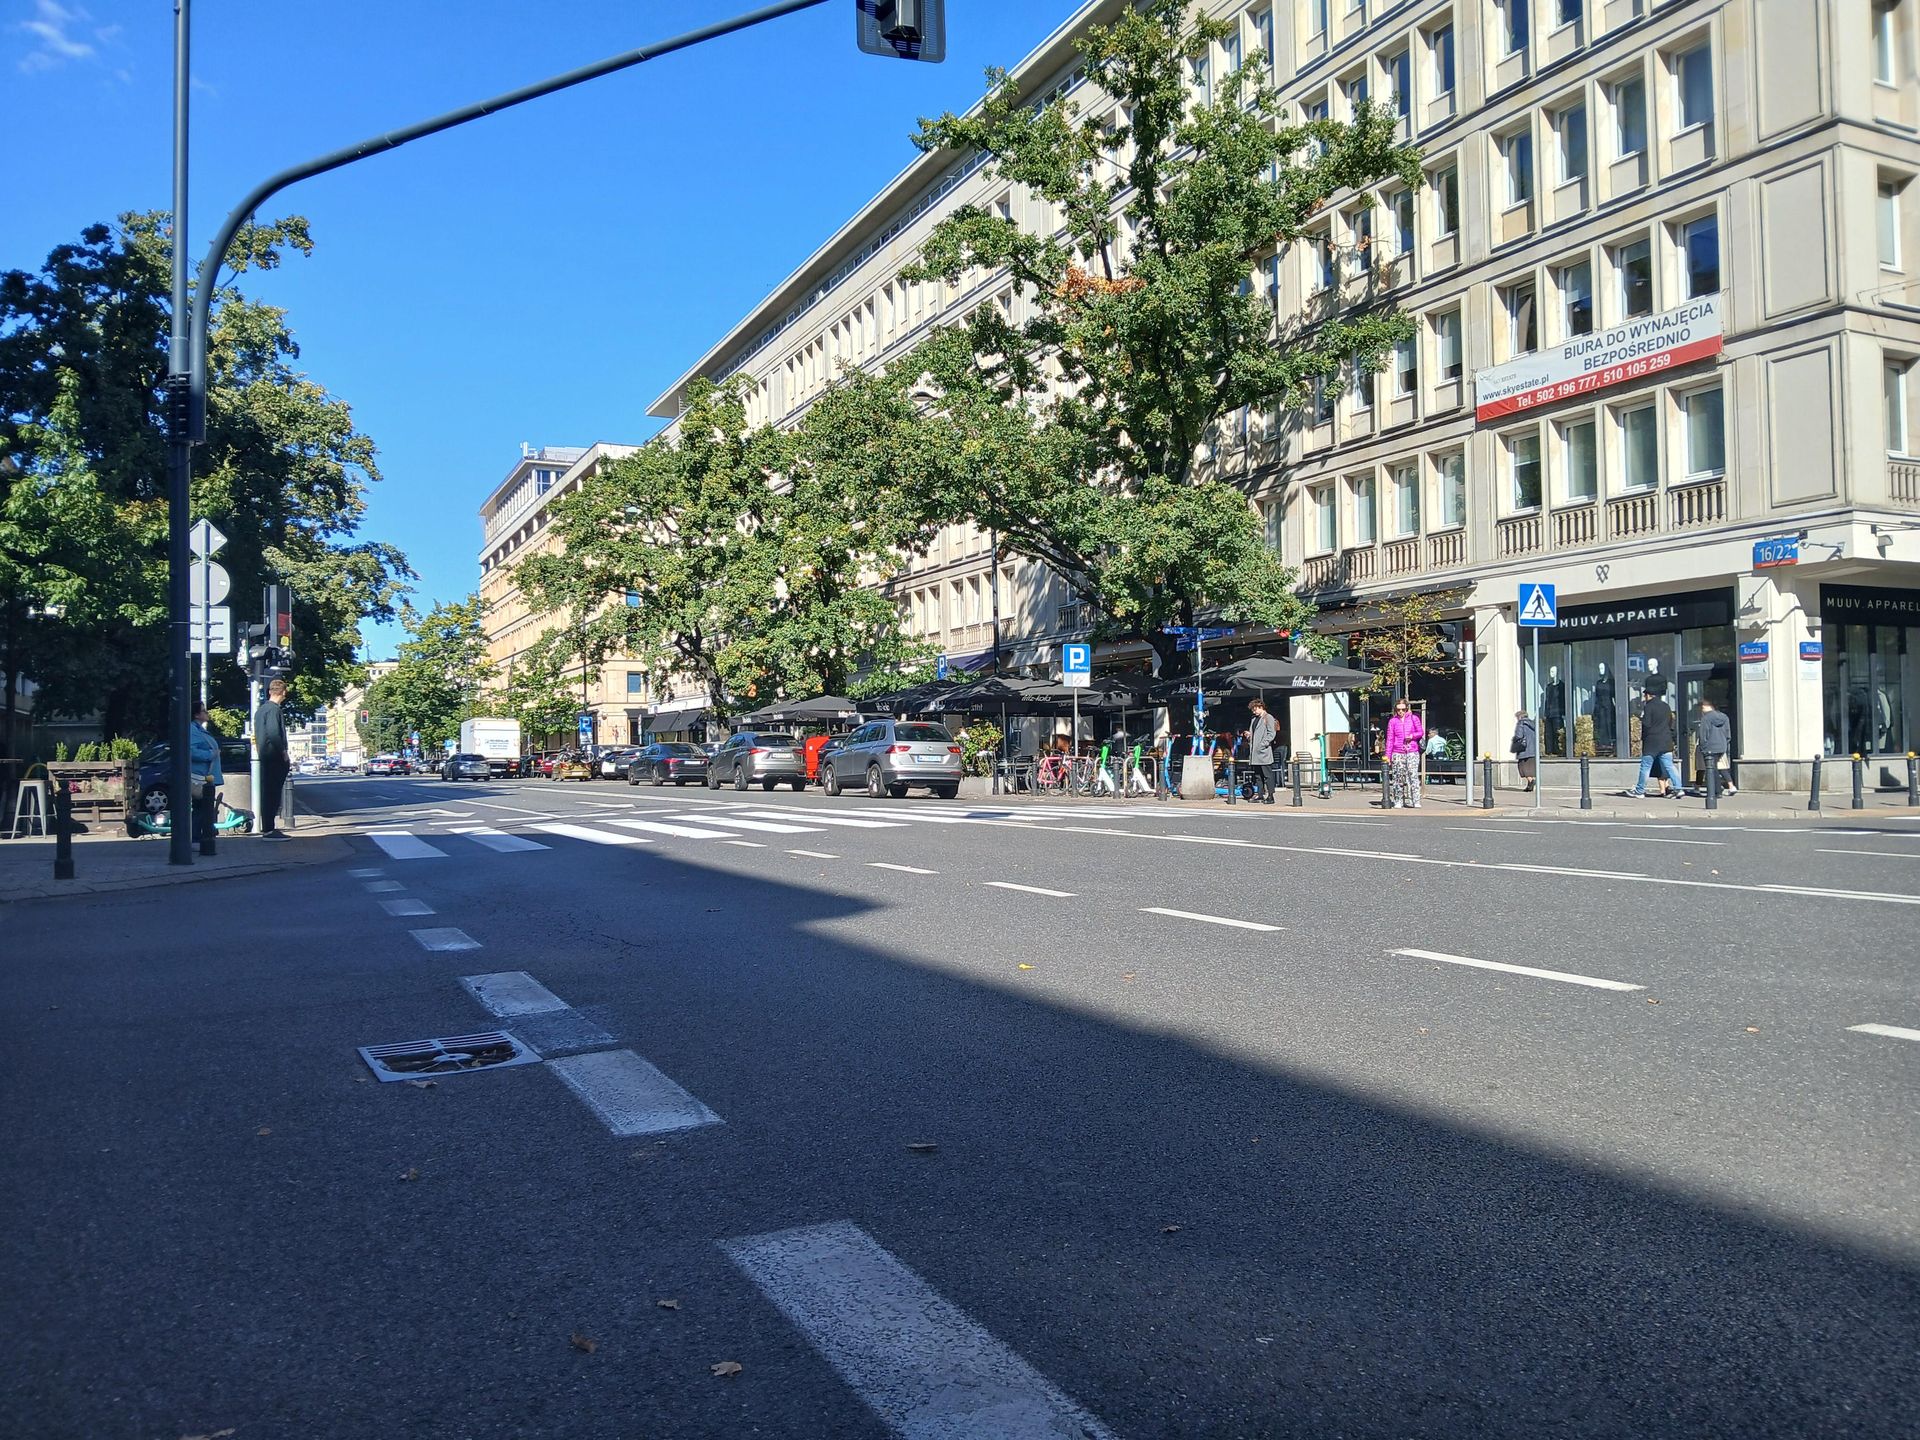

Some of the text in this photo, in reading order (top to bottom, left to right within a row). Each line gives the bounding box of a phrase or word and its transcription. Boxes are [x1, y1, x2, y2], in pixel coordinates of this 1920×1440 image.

[1564, 302, 1714, 360] BIURA DO WYNAJĘCIA
[1584, 328, 1691, 371] BEZPOŚREDNIO
[1482, 373, 1550, 401] www.skyestate.pl
[1516, 353, 1671, 408] Tel. 502 196 777, 510 105 259
[1759, 544, 1792, 562] 16/22
[1559, 606, 1679, 628] MUUV.APPAREL
